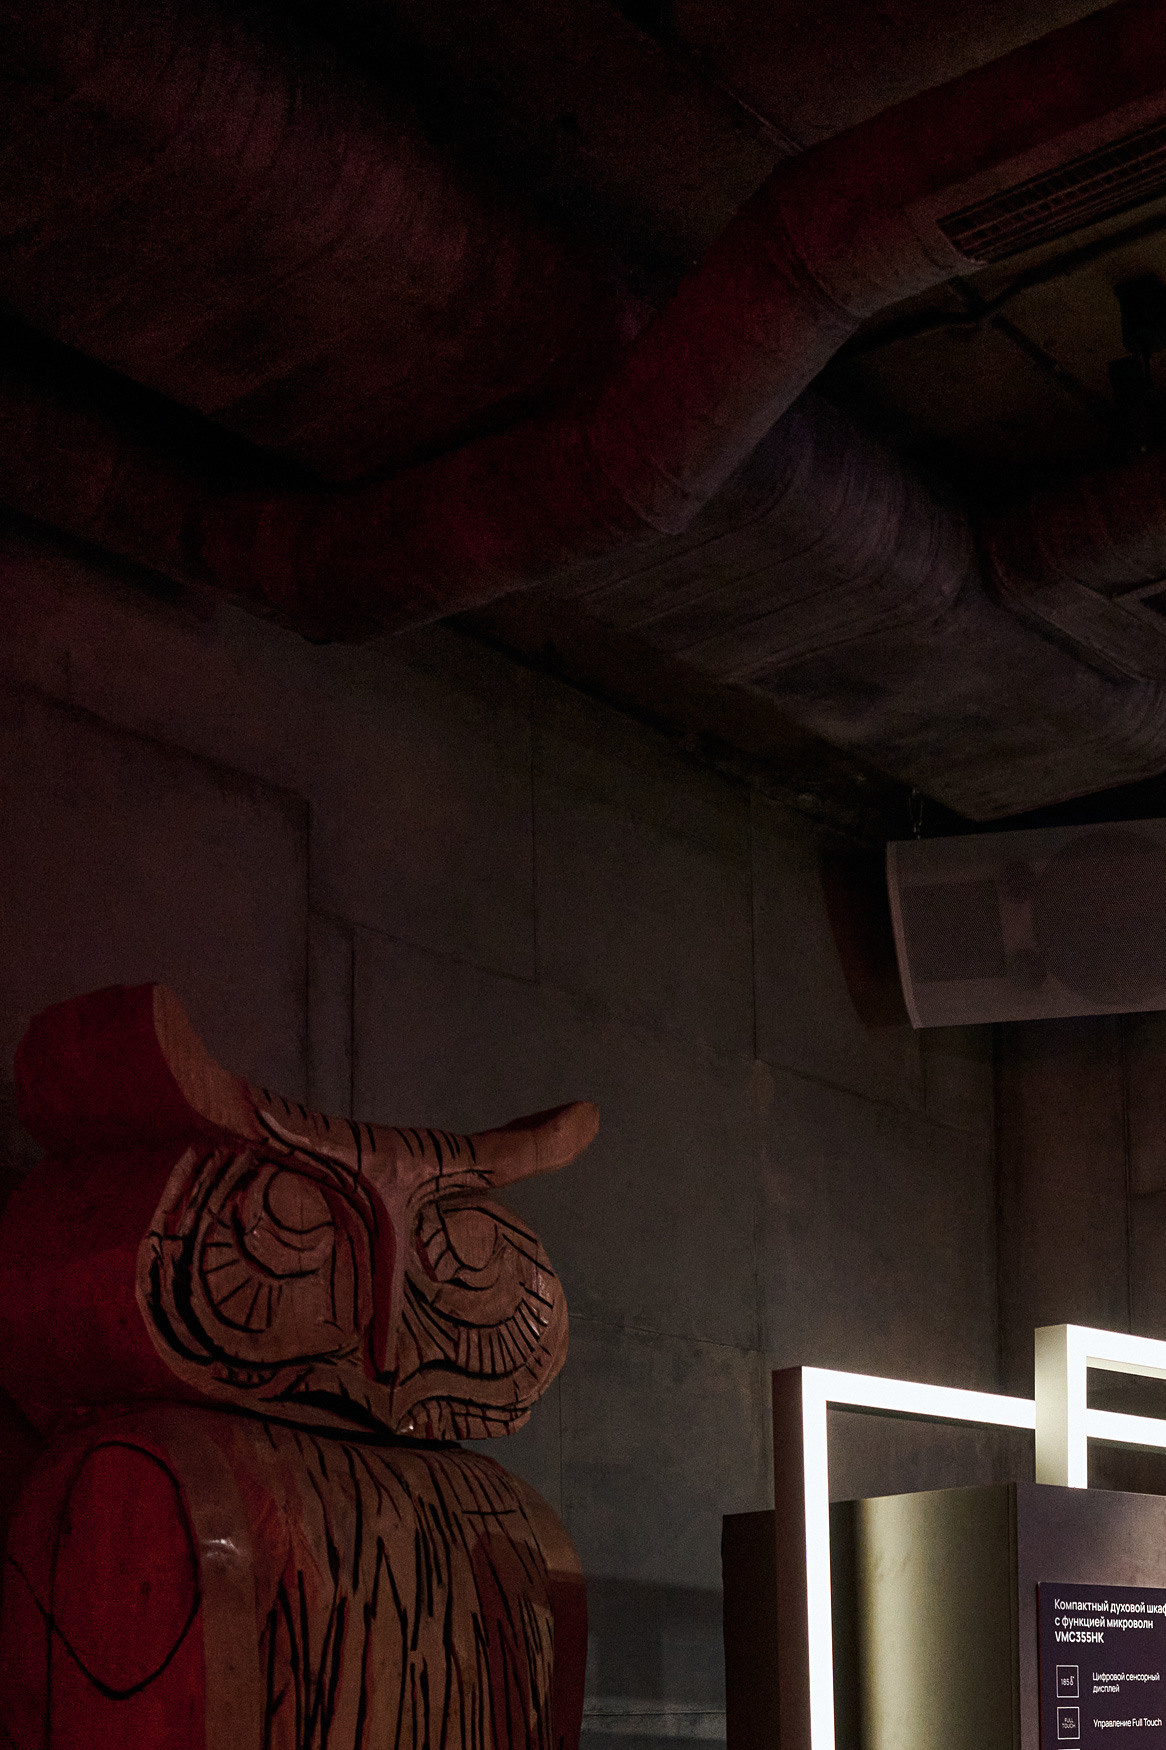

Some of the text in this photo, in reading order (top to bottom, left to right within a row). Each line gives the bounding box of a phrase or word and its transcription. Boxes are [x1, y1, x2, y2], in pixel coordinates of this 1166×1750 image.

[1054, 1598, 1109, 1612] Компактный
[1110, 1602, 1146, 1615] духовой
[1054, 1615, 1154, 1631] с функцией микроволн
[1054, 1631, 1105, 1644] VMC355HK
[1092, 1672, 1160, 1683] Цифровой сенсорный
[1092, 1684, 1120, 1693] дисплей
[1093, 1718, 1163, 1730] Управление Full Touch
